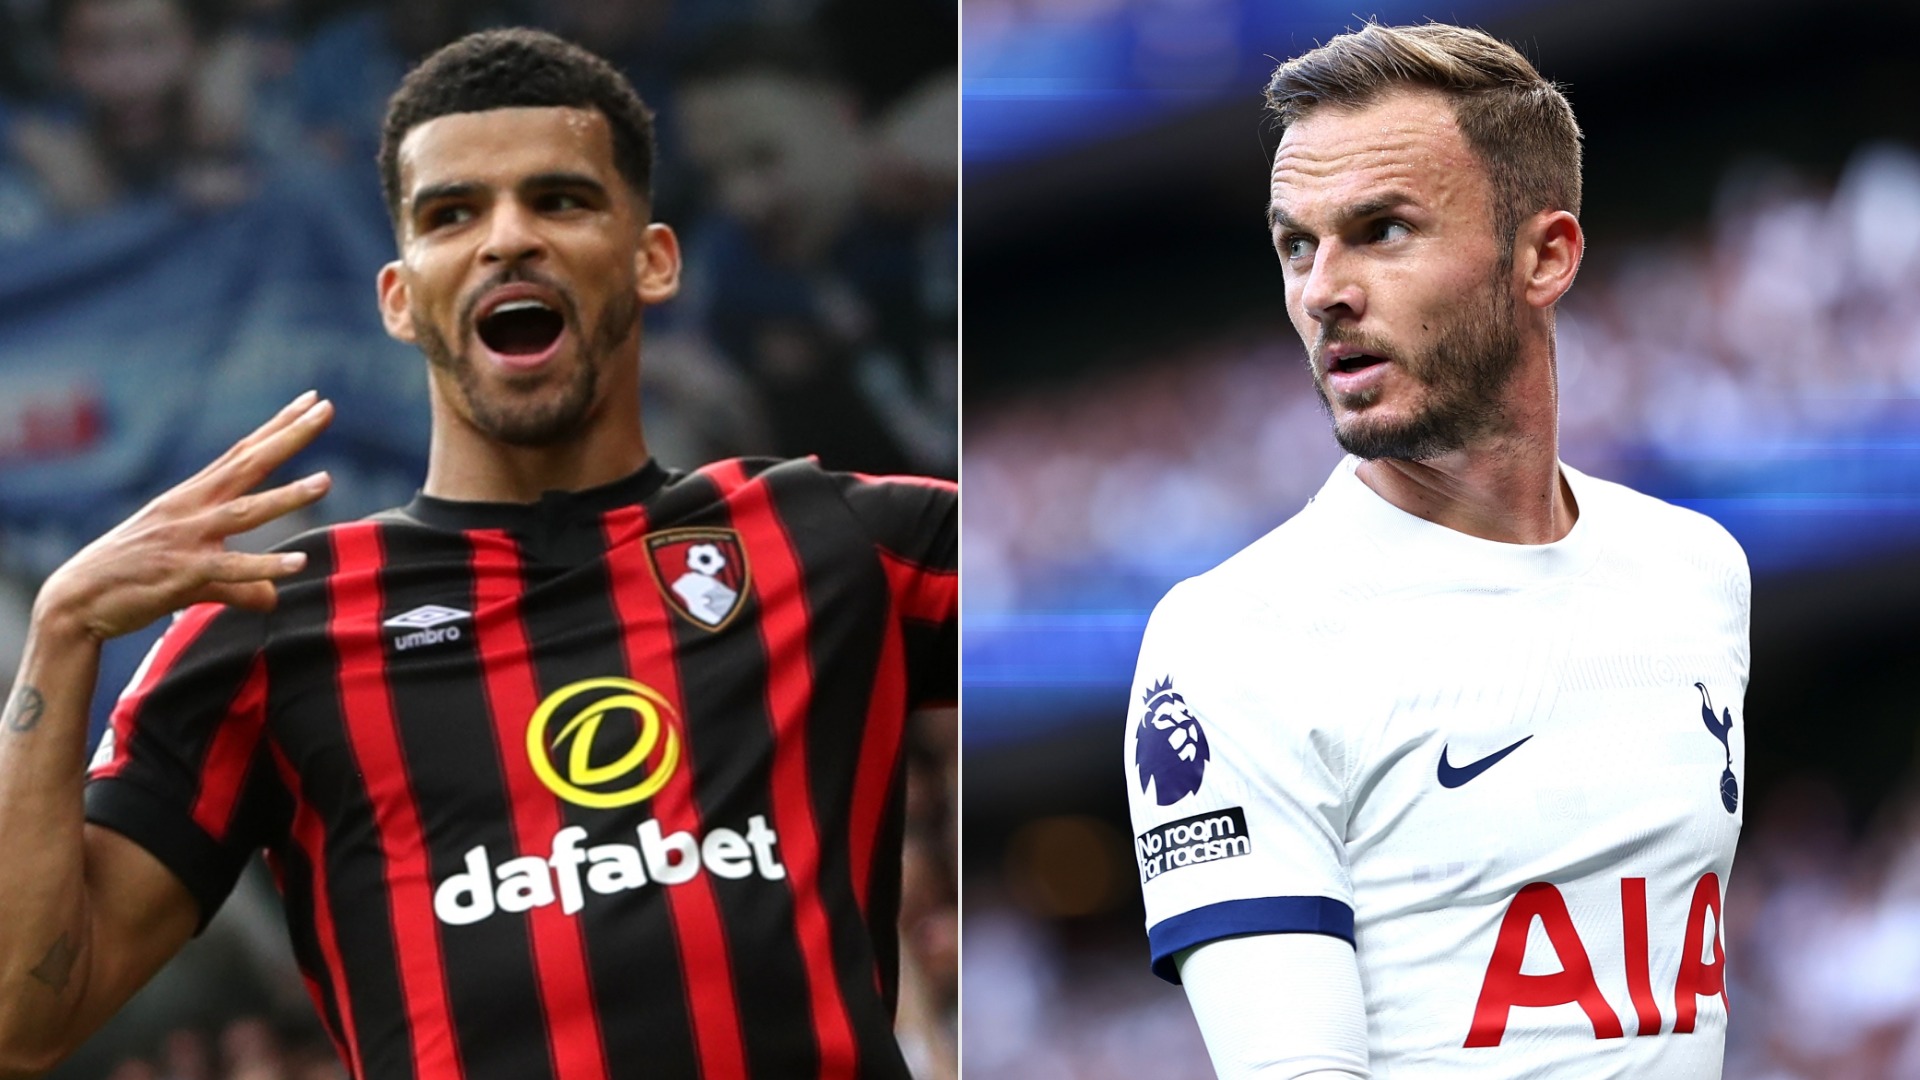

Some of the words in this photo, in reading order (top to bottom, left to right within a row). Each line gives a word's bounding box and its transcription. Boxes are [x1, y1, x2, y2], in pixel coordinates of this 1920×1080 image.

[394, 626, 460, 651] umbro
[1138, 833, 1162, 858] No
[1164, 815, 1235, 848] room
[1165, 835, 1250, 870] racism
[434, 814, 785, 925] dafabet
[1462, 872, 1730, 1048] AIA
